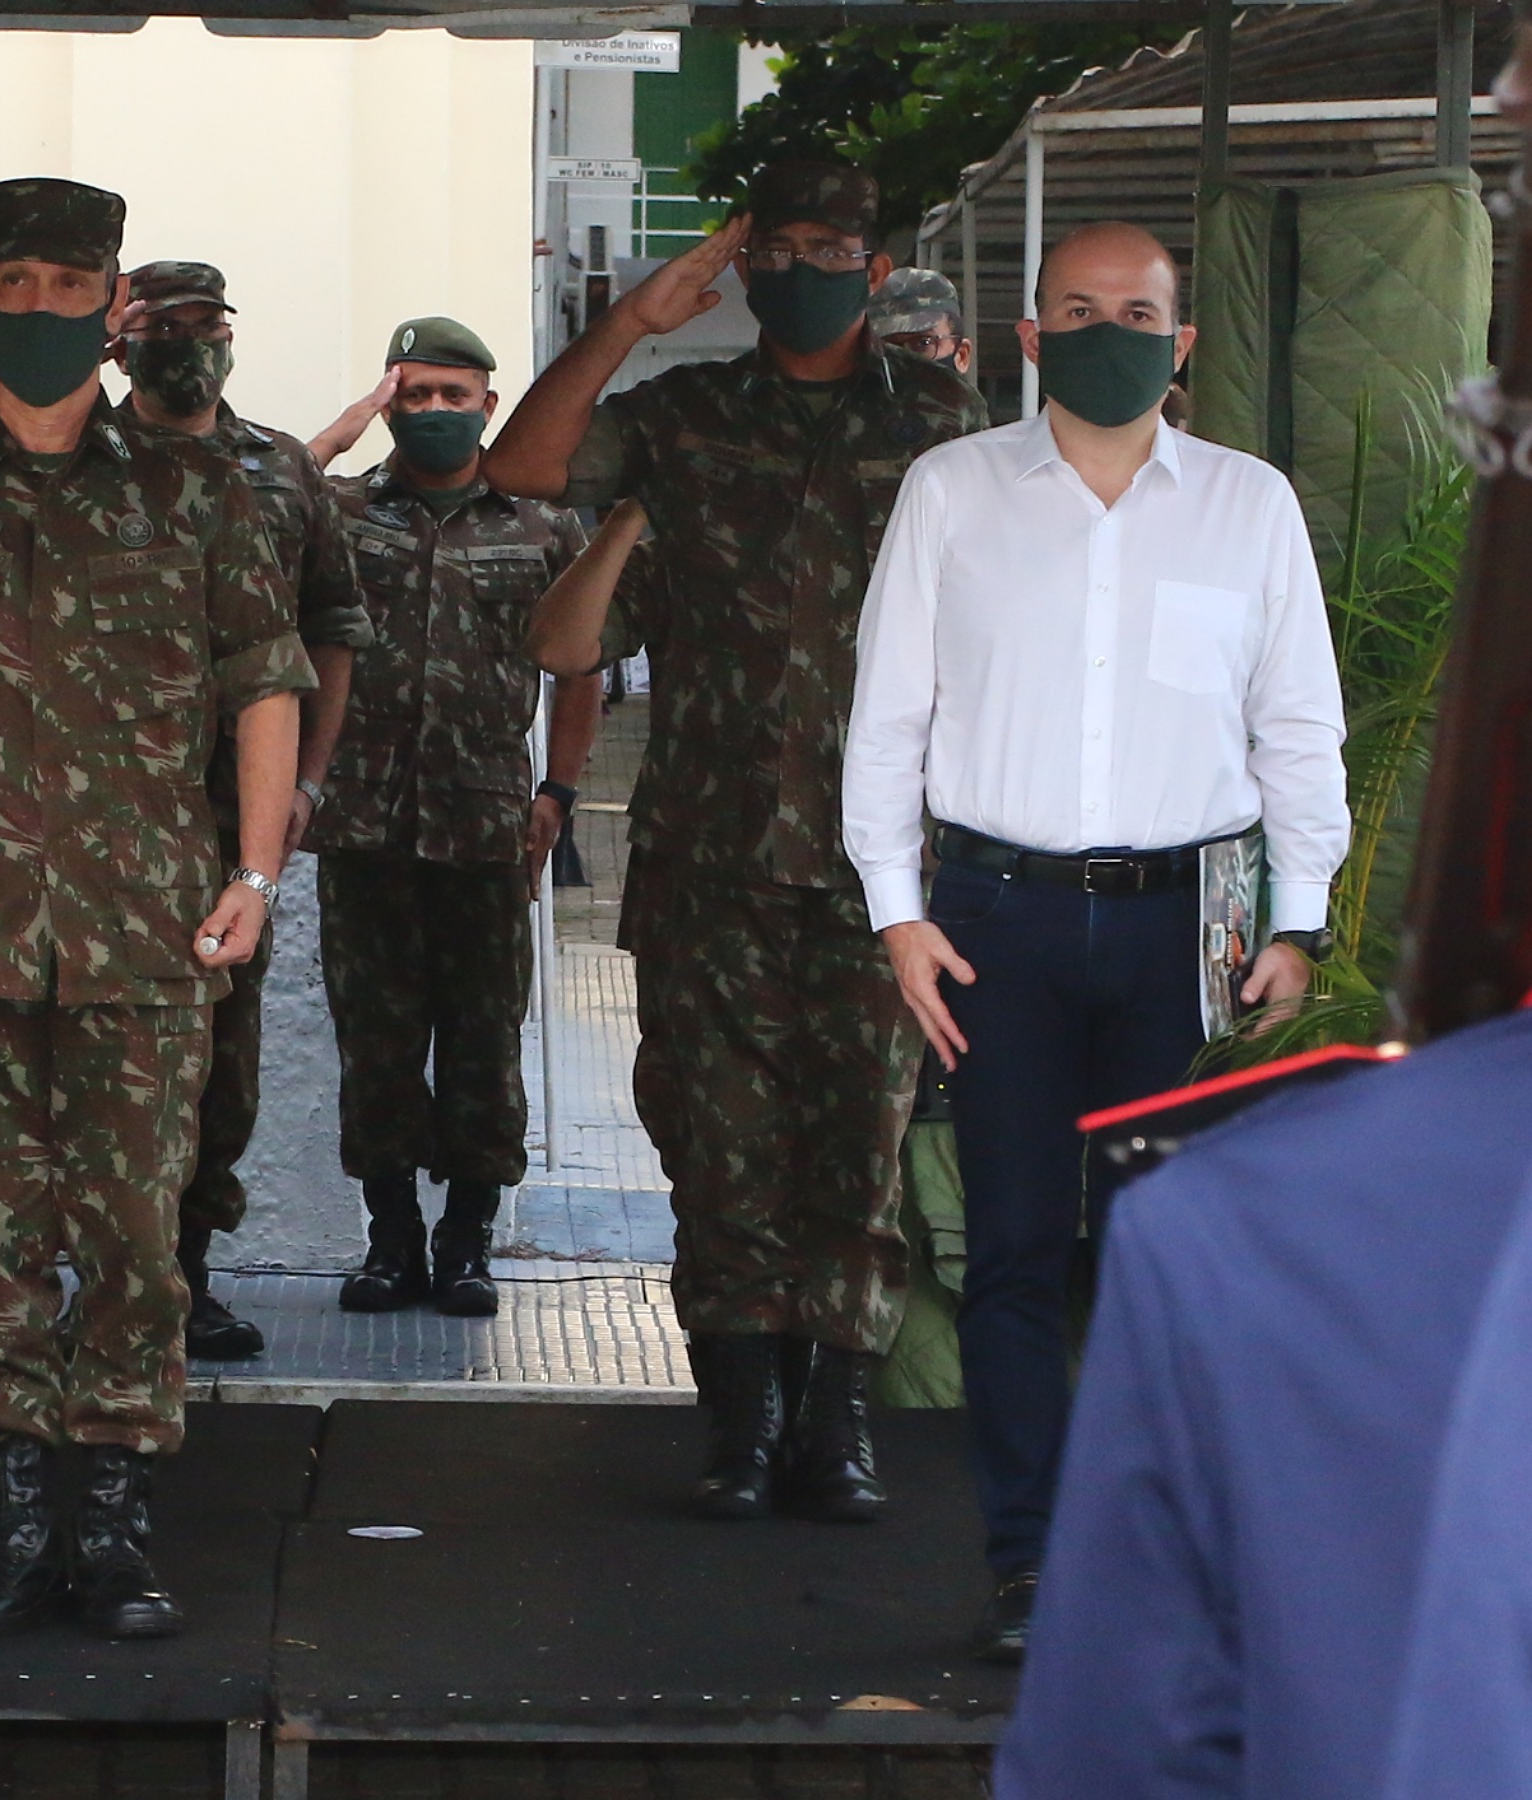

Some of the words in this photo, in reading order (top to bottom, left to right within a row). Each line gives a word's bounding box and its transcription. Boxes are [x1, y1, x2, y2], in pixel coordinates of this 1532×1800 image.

[610, 39, 624, 49] de
[628, 39, 675, 51] Inativos
[574, 53, 581, 62] e
[585, 52, 661, 65] Pensionistas
[576, 169, 595, 177] FEM
